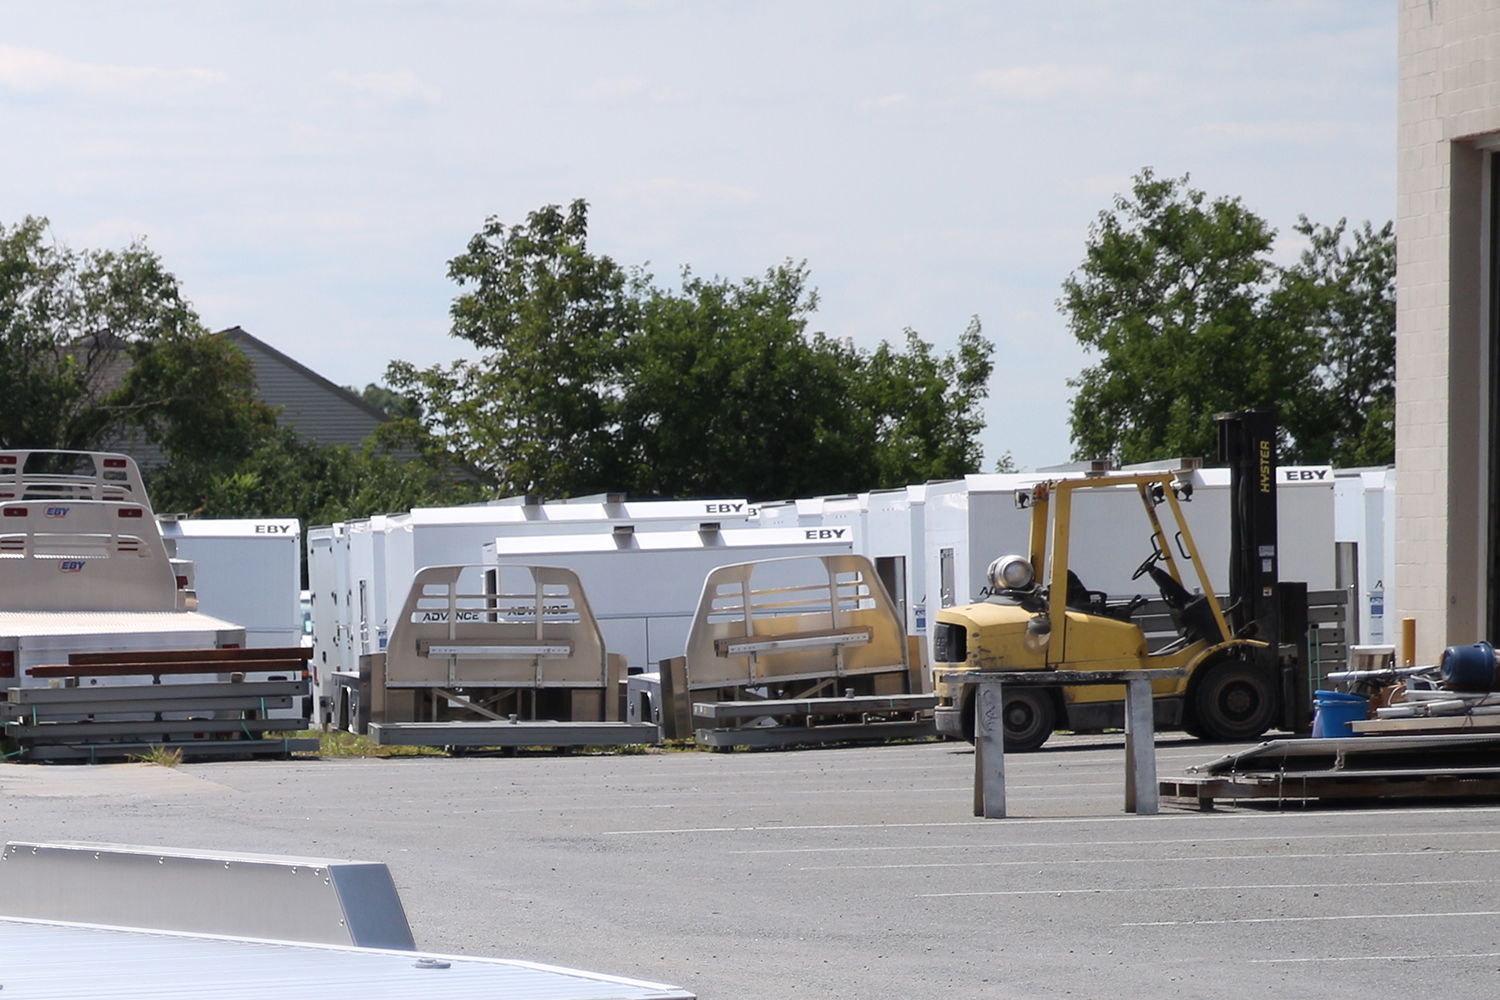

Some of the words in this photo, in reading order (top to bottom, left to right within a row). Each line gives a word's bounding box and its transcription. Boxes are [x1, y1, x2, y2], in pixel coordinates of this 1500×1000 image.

[1260, 440, 1270, 493] HYSTER
[1285, 470, 1328, 481] EBY
[46, 507, 70, 516] EBY
[705, 503, 744, 513] EBY
[254, 525, 291, 533] EBY
[805, 529, 846, 539] EBY
[61, 561, 86, 570] EBY
[507, 605, 568, 616] ADVNCE
[422, 612, 480, 621] ADVNCE
